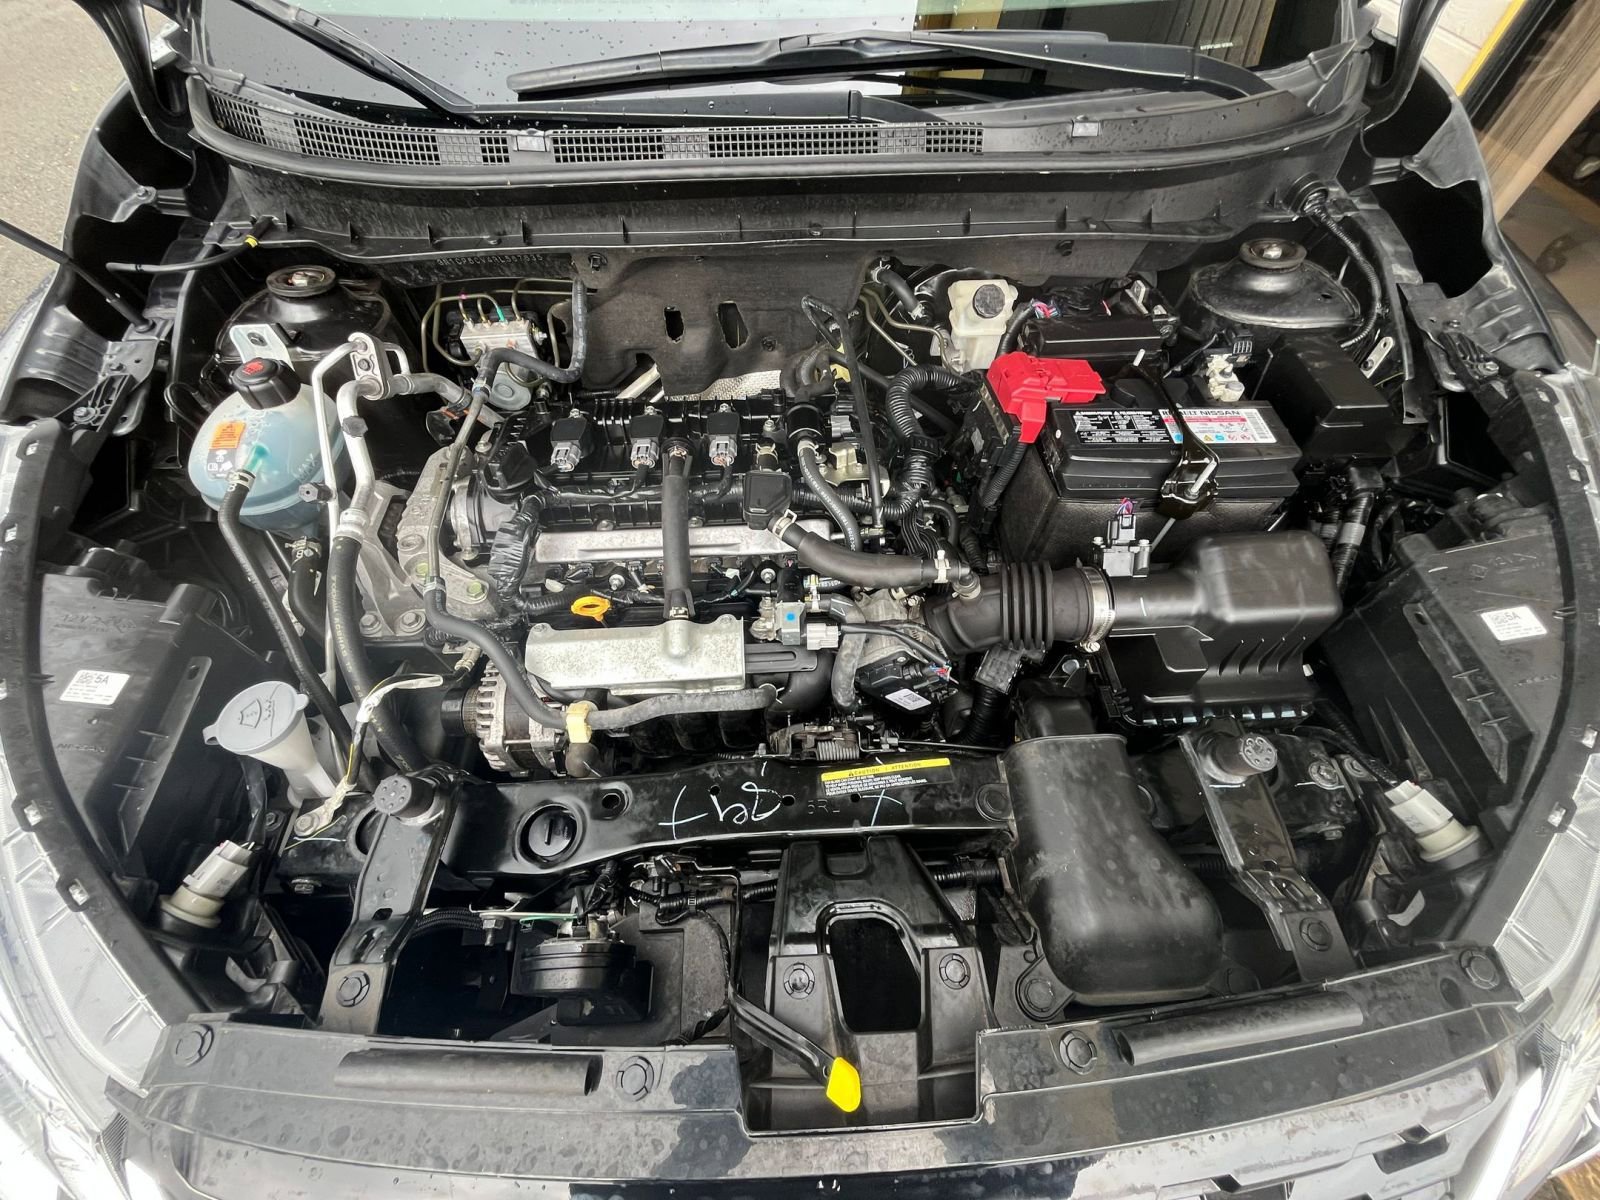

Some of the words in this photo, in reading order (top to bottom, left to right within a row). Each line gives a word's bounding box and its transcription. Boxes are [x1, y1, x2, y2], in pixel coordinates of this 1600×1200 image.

[1504, 611, 1521, 621] 5A
[94, 674, 110, 685] 5A
[854, 767, 880, 776] CAUTION
